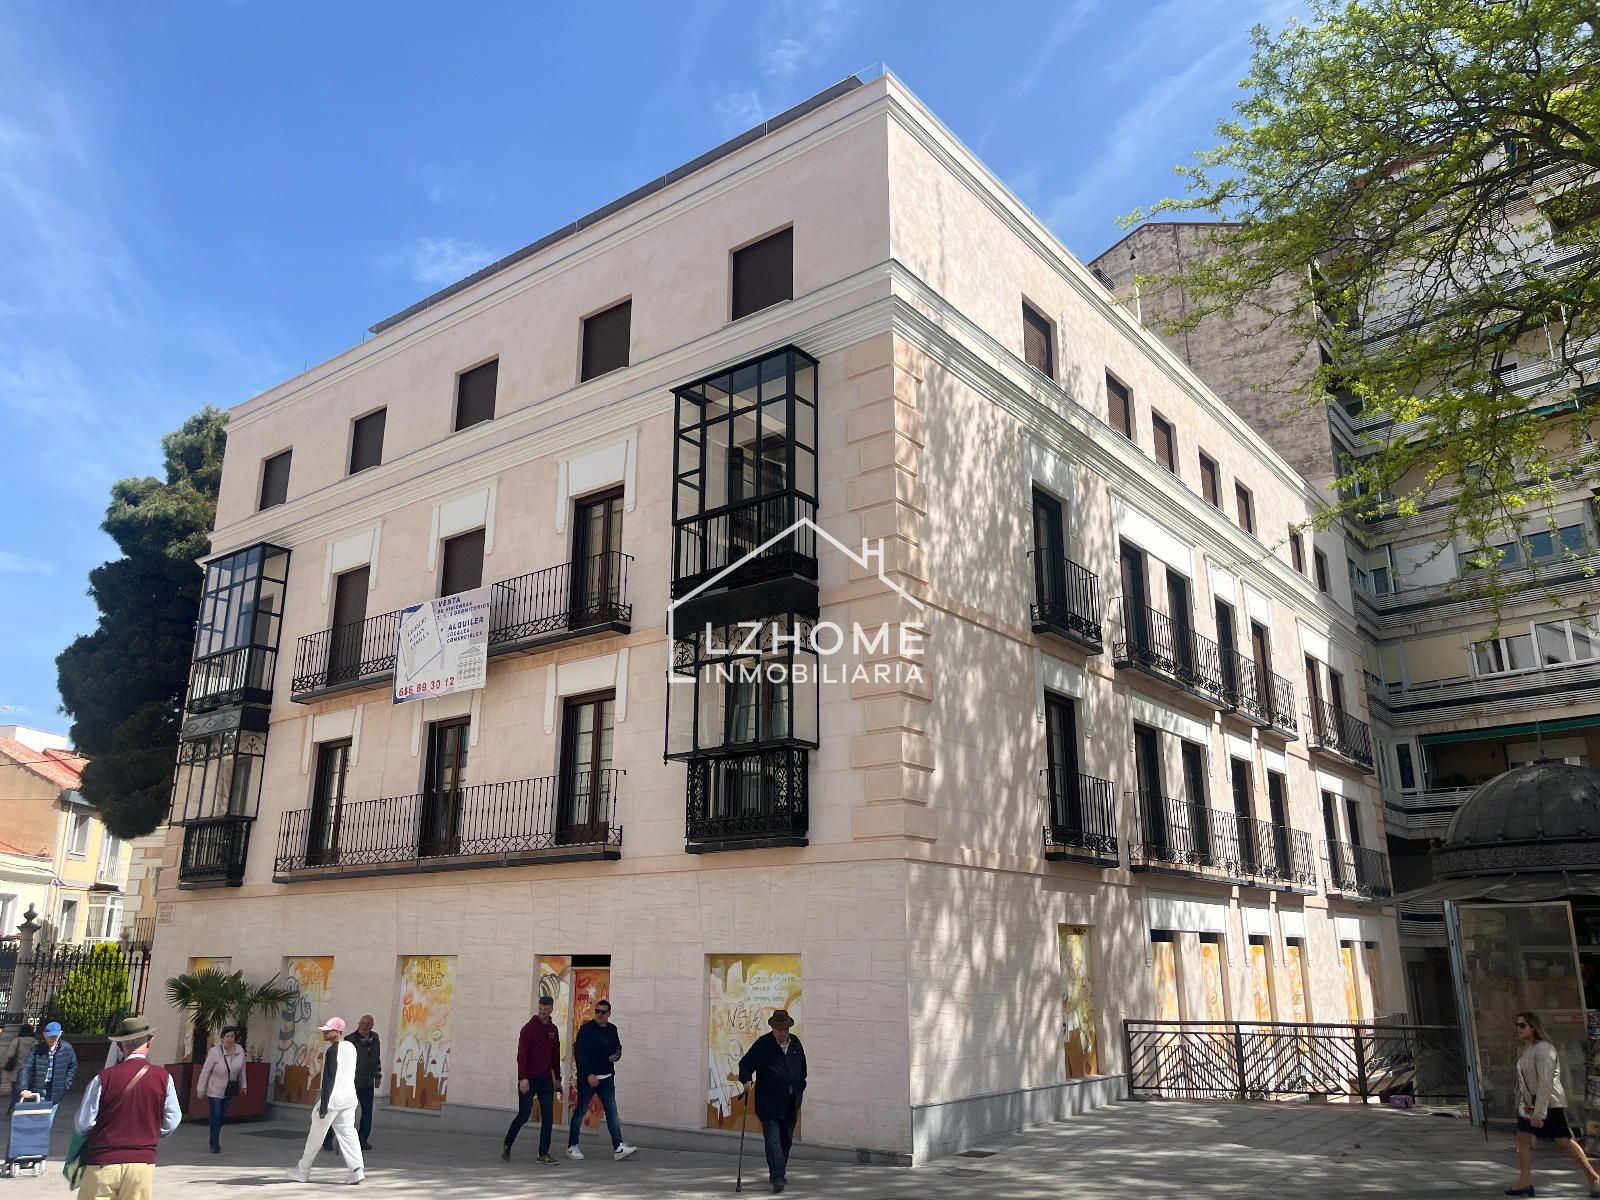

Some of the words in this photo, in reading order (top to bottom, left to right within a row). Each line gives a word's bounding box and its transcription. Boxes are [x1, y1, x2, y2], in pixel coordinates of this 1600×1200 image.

[438, 596, 461, 607] VENTA
[454, 602, 490, 617] DORMITORIOS
[448, 616, 484, 631] ALQUILER
[446, 631, 483, 644] COMERCIALES
[447, 628, 470, 638] LOCALES
[416, 682, 427, 692] 89
[430, 679, 441, 690] 30
[445, 676, 455, 687] 12
